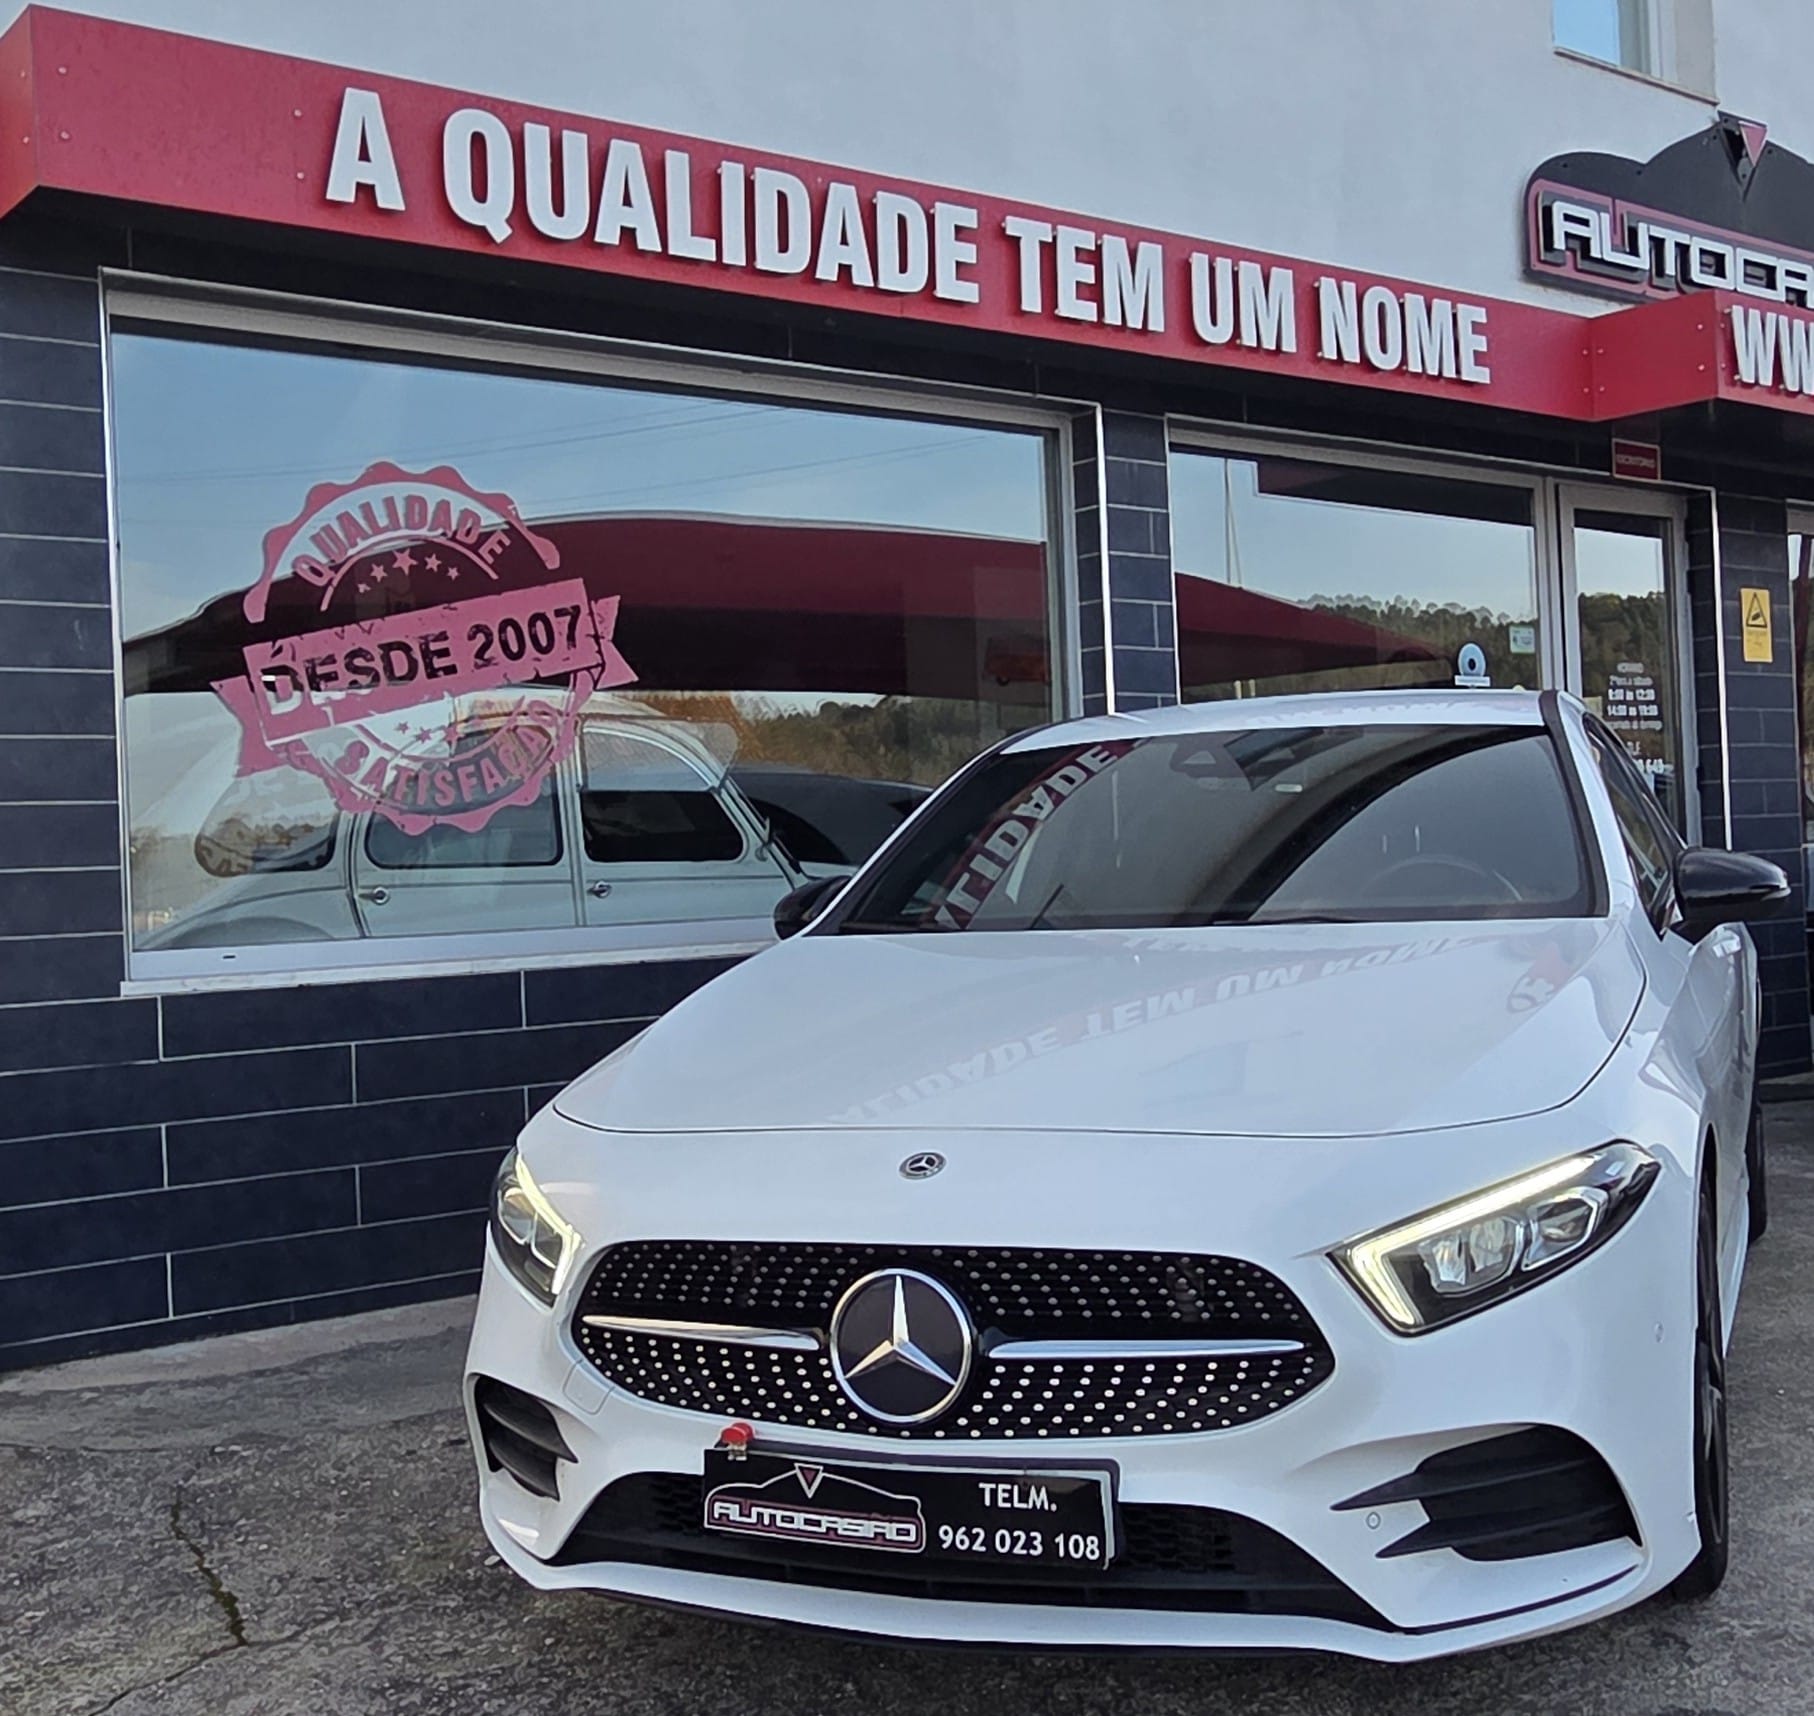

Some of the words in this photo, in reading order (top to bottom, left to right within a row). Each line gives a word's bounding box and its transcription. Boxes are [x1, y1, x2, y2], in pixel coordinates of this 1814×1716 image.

[326, 87, 405, 211] A
[443, 107, 980, 303] QUALIDADE
[1005, 215, 1165, 333] TEM
[1190, 252, 1297, 354] UM
[1319, 276, 1491, 384] NOME
[292, 494, 511, 588] QUALIDADE
[260, 630, 458, 715] DESDE
[466, 604, 582, 669] 2007
[938, 1525, 987, 1552] 962
[995, 1529, 1043, 1556] 023
[1055, 1533, 1100, 1560] 108
[979, 1482, 1057, 1512] TELM.
